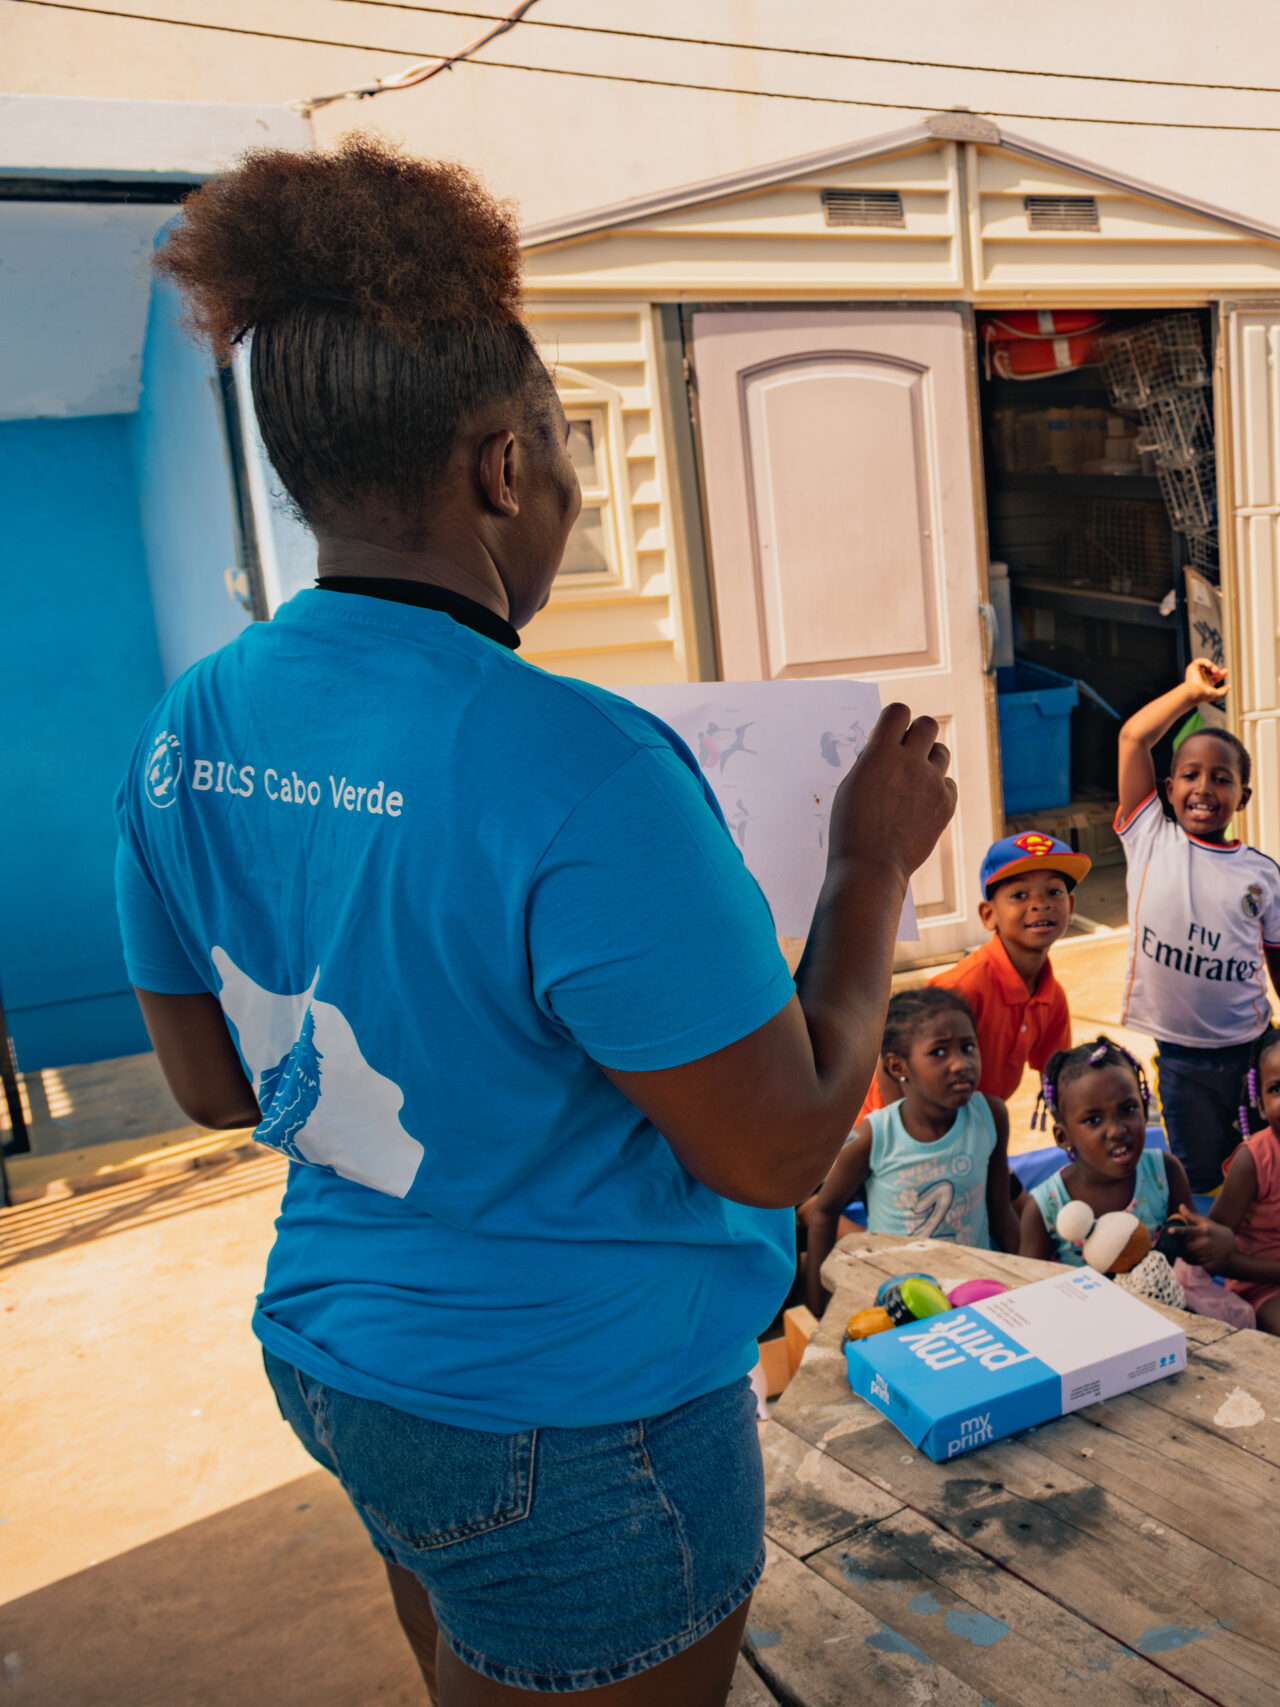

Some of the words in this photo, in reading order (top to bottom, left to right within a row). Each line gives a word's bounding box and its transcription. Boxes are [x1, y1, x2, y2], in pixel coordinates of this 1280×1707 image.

[192, 759, 255, 797] BICS
[264, 769, 320, 806] Cabo
[329, 775, 403, 817] Verde
[1142, 926, 1258, 982] Emirates
[1188, 923, 1221, 950] Fly
[898, 1331, 966, 1371] my
[929, 1314, 1037, 1371] print
[870, 1380, 890, 1405] print
[948, 1424, 994, 1458] print
[961, 1412, 990, 1435] my
